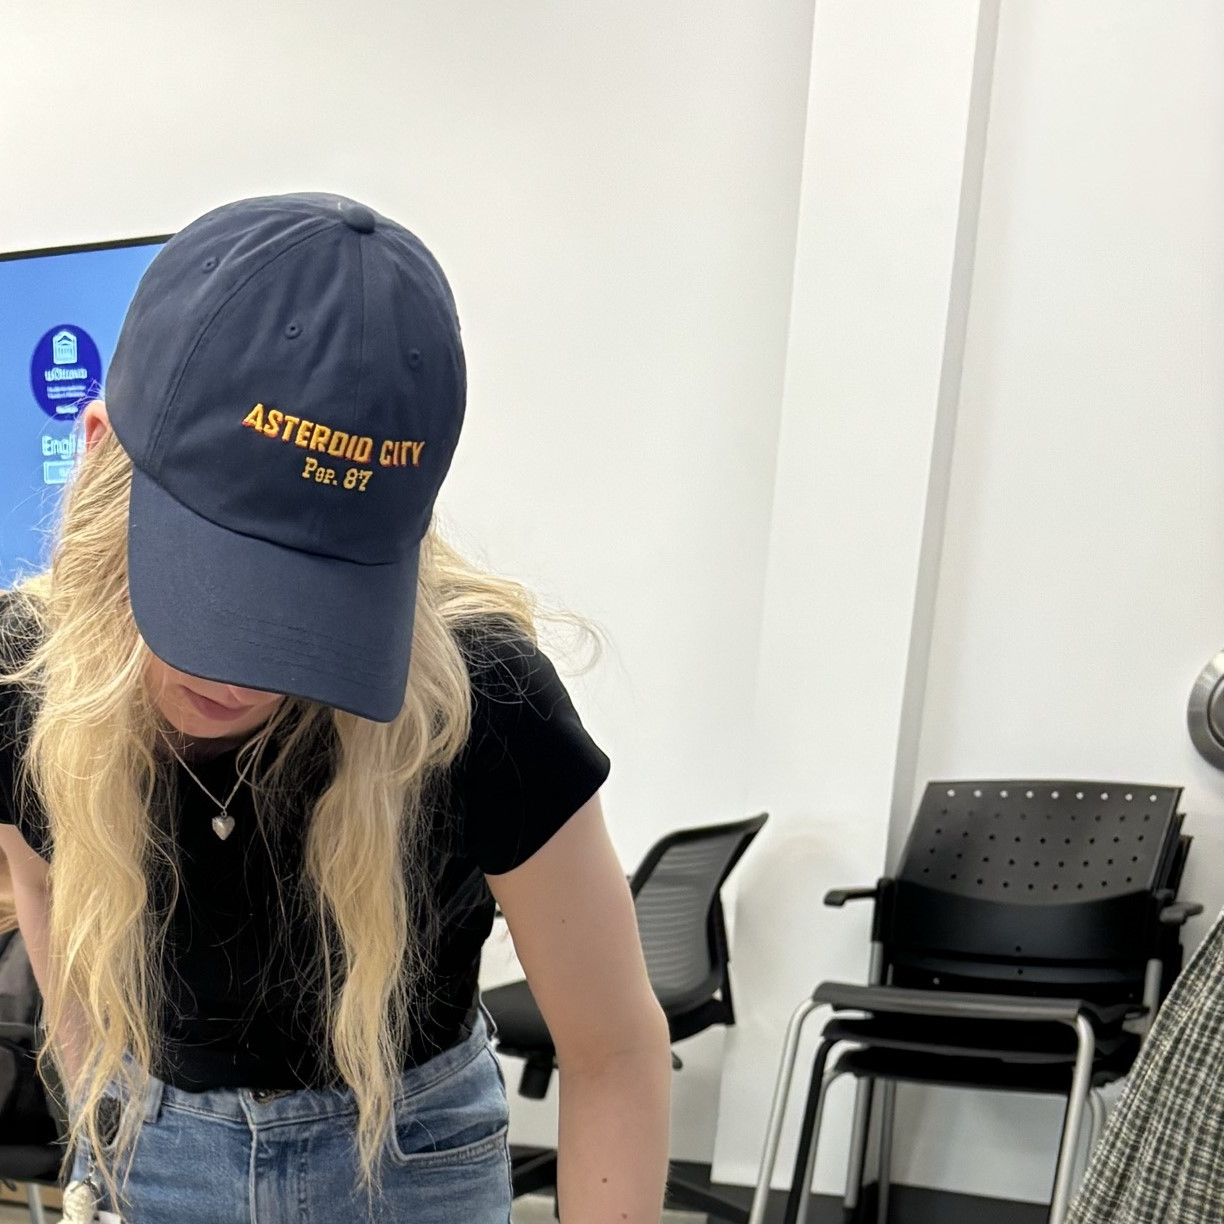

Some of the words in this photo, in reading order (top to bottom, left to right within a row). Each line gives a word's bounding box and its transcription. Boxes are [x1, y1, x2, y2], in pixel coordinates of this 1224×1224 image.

[241, 403, 373, 464] ASTEROID
[379, 440, 425, 467] CITY
[343, 467, 373, 491] 87
